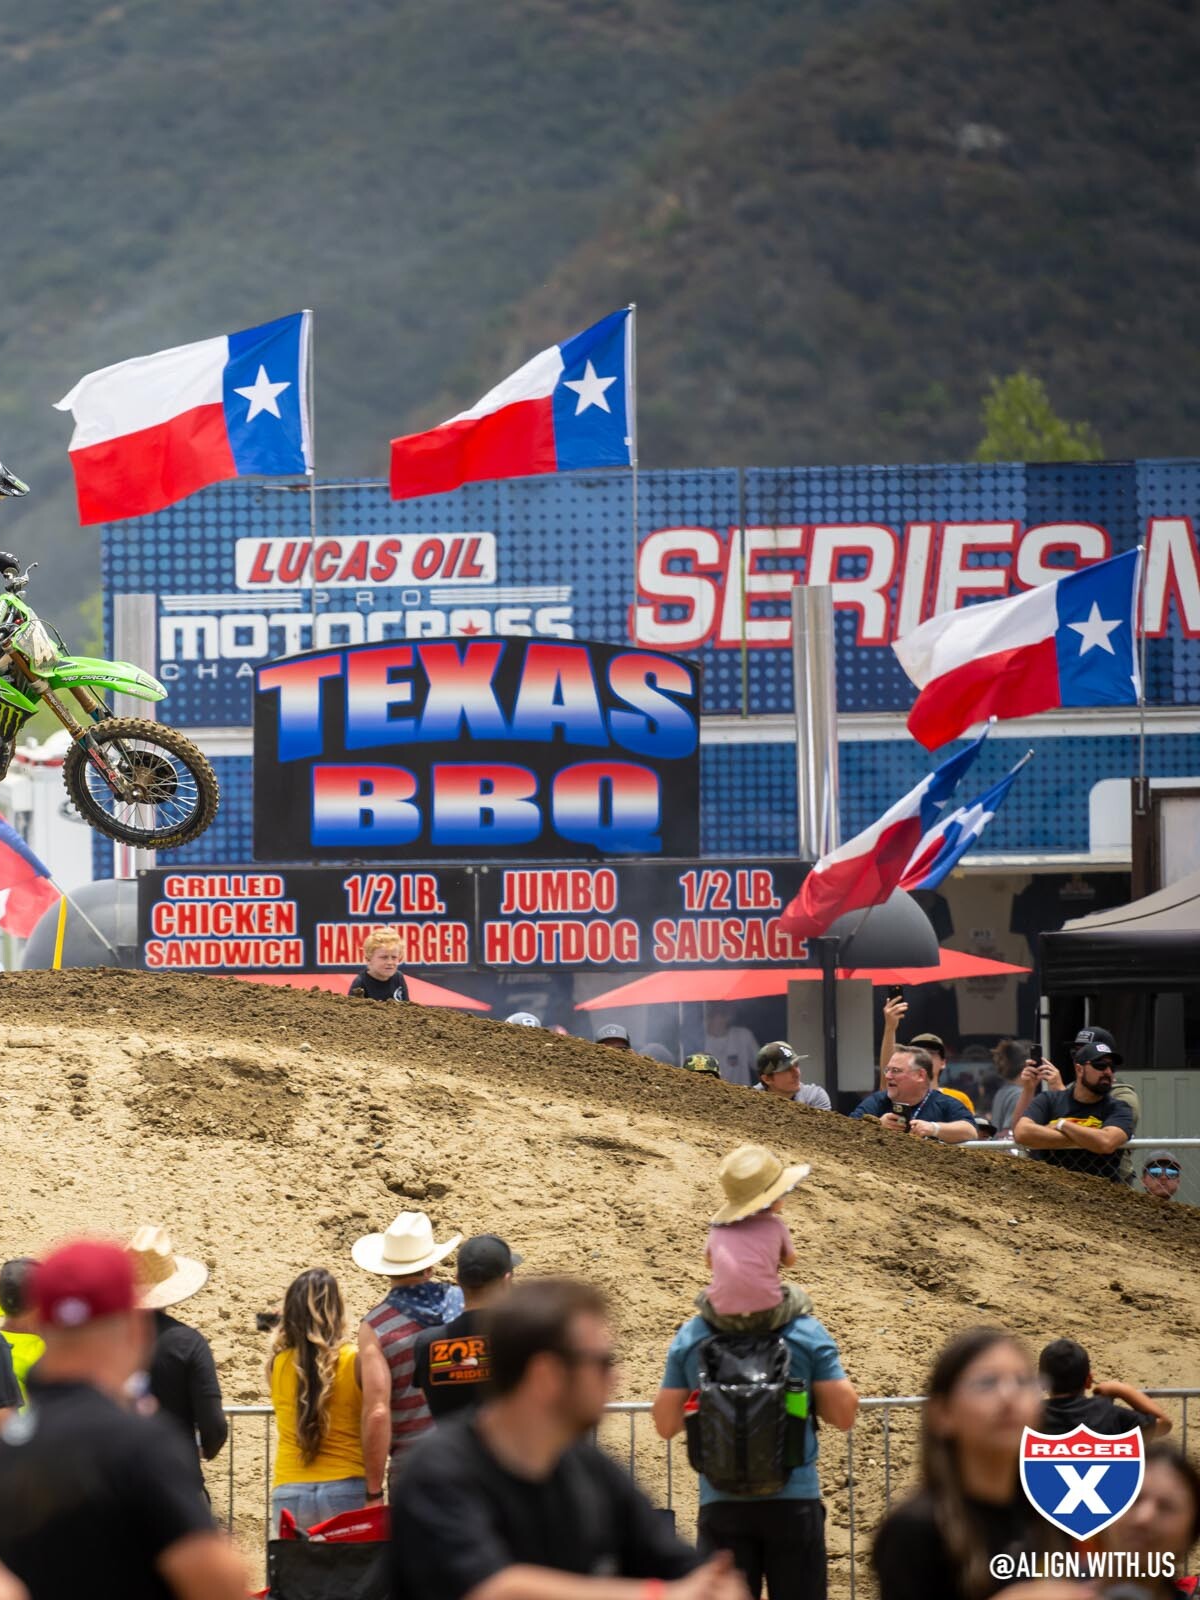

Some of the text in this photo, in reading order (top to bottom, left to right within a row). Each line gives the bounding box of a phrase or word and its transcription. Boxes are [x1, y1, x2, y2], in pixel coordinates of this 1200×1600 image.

[247, 538, 485, 583] LUCAS OIL
[315, 590, 422, 606] PRO
[158, 607, 574, 660] MOTOCROSS
[257, 638, 699, 762] TEXAS
[310, 761, 662, 854] BBQ
[164, 876, 283, 898] GRILLED
[344, 874, 446, 914] 1/2 LB.
[501, 869, 617, 914] JUMBO
[680, 870, 782, 911] 1/2 LB.
[152, 901, 296, 937] CHICKEN
[653, 918, 808, 962] SAUSAGE
[145, 939, 303, 967] SANDWICH
[317, 922, 468, 965] HAMRGER
[485, 919, 639, 964] HOTDOG
